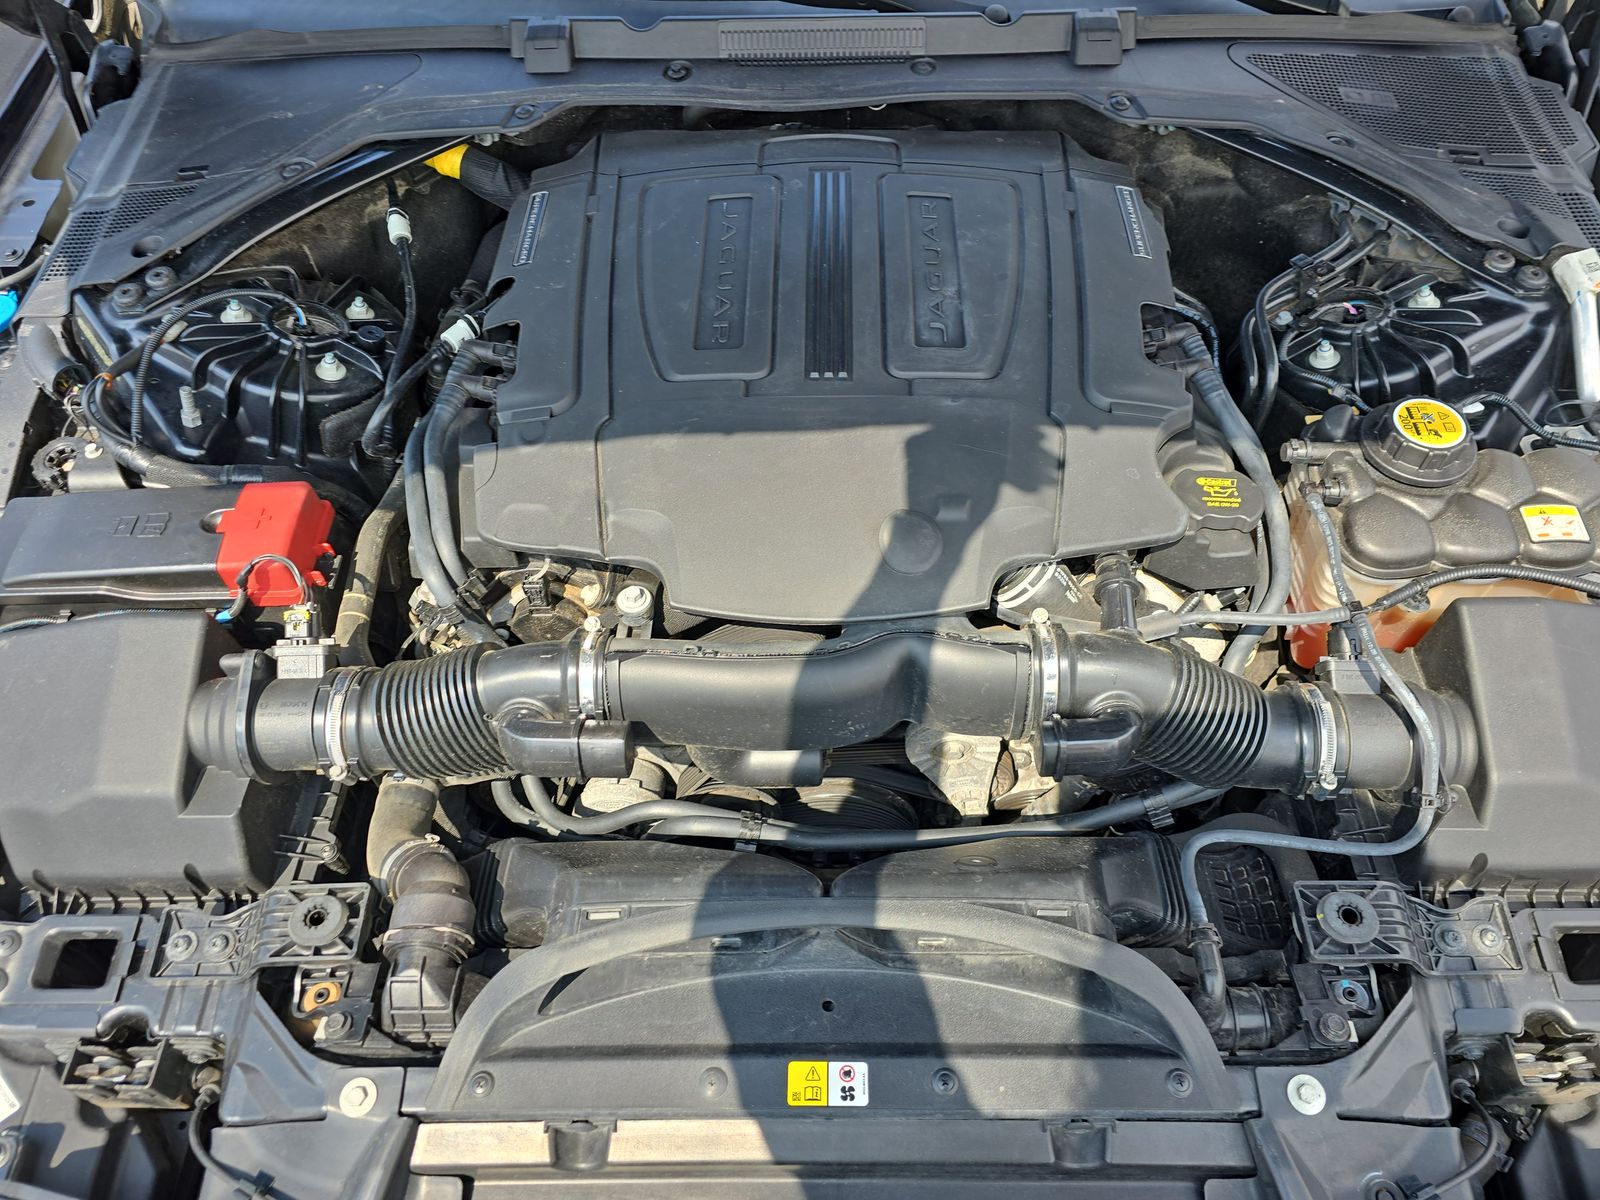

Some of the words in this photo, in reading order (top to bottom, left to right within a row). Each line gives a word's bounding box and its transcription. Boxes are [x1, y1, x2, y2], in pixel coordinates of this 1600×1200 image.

[711, 202, 738, 343] JAGUAR
[920, 200, 948, 343] JAGUAR
[1399, 414, 1413, 430] 200
